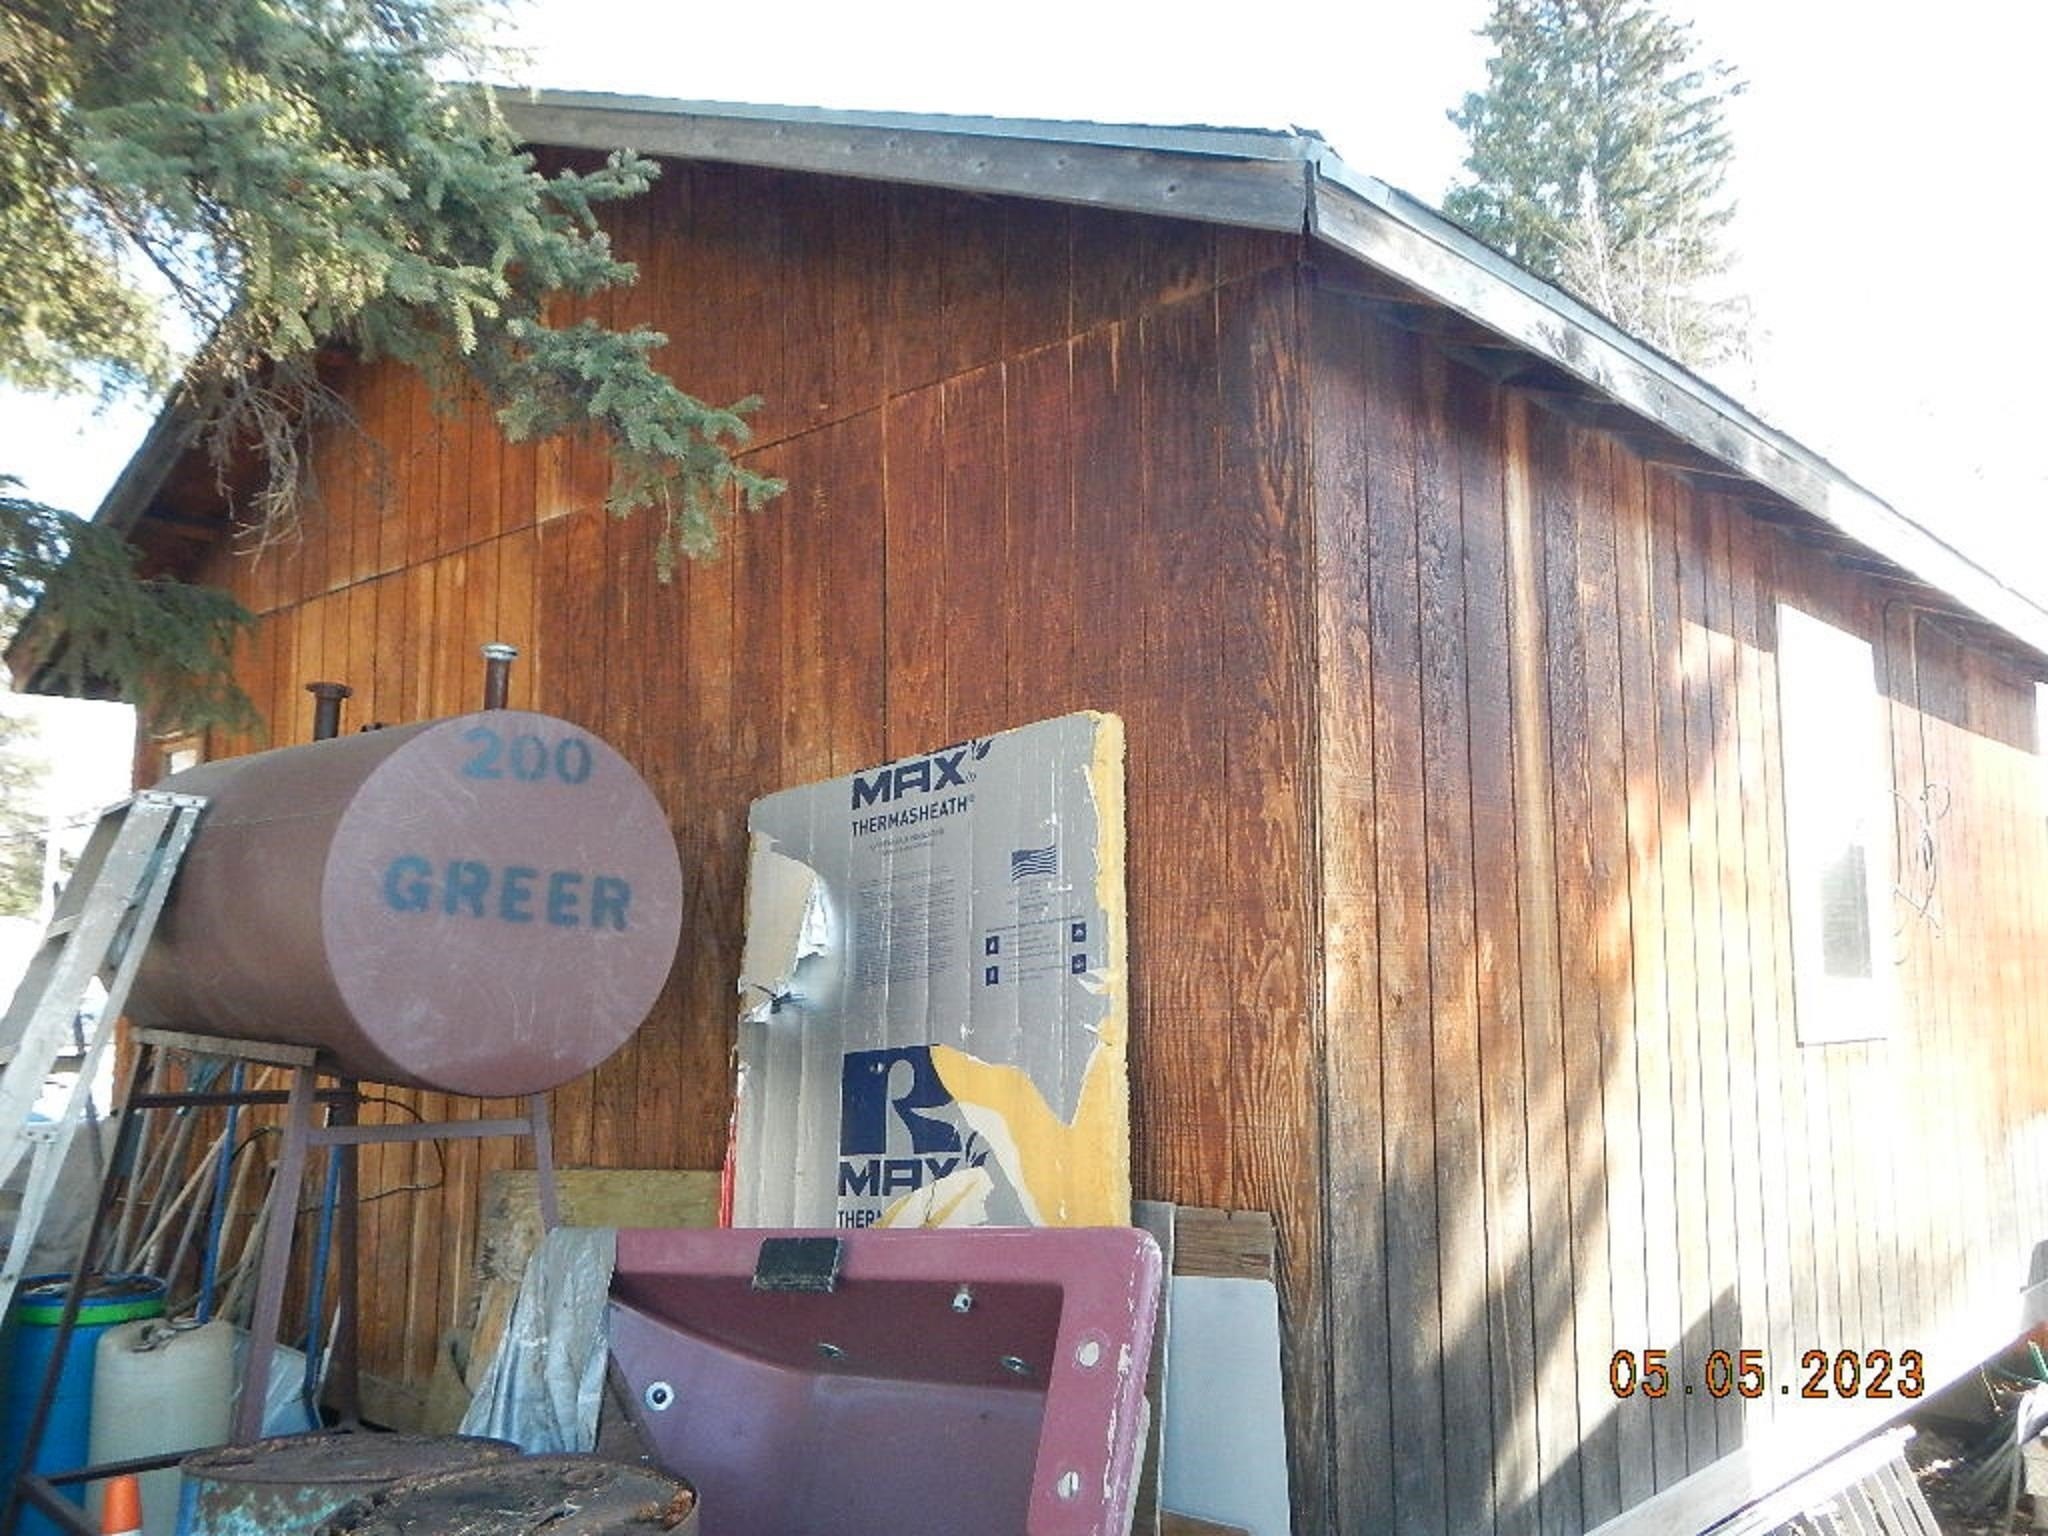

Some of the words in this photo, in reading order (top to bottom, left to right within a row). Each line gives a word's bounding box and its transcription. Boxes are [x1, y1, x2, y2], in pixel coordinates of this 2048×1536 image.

[461, 726, 593, 784] 200
[852, 750, 967, 811] MAX
[852, 796, 968, 837] THERMASHEATH
[384, 854, 633, 932] GREER
